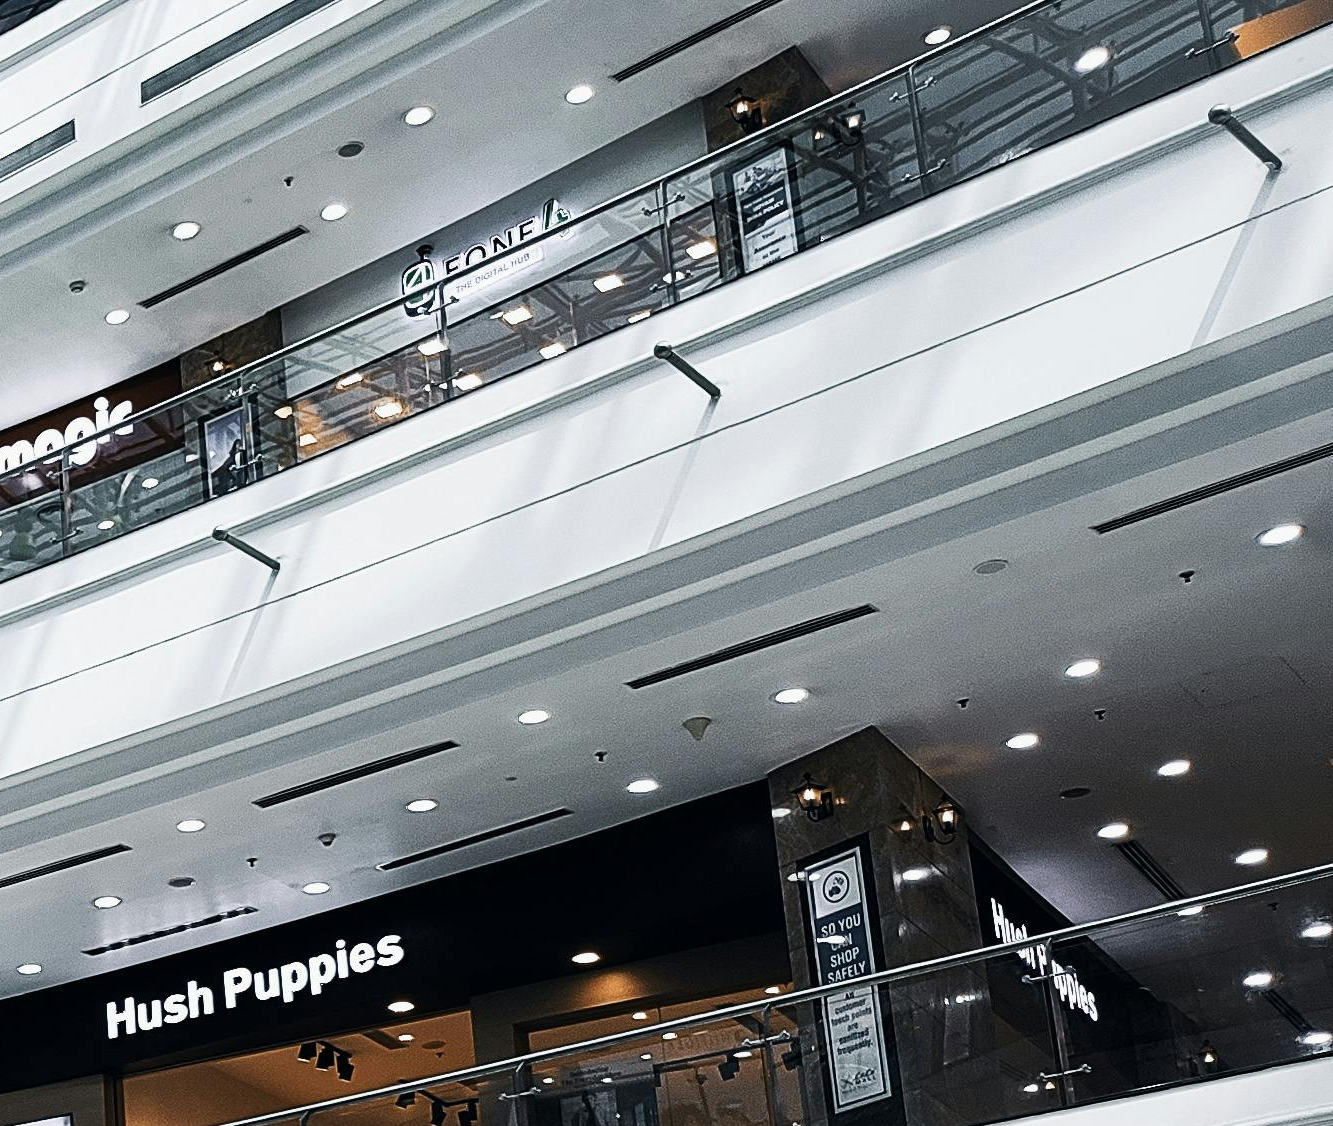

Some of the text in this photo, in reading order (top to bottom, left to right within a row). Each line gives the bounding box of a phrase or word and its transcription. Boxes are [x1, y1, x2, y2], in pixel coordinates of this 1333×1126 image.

[475, 263, 510, 284] DIGITAL
[511, 252, 531, 269] HUB
[821, 913, 862, 939] SO YOU
[830, 948, 860, 968] SHOP
[828, 961, 866, 984] SAFELY
[106, 934, 405, 1039] Hush Puppies
